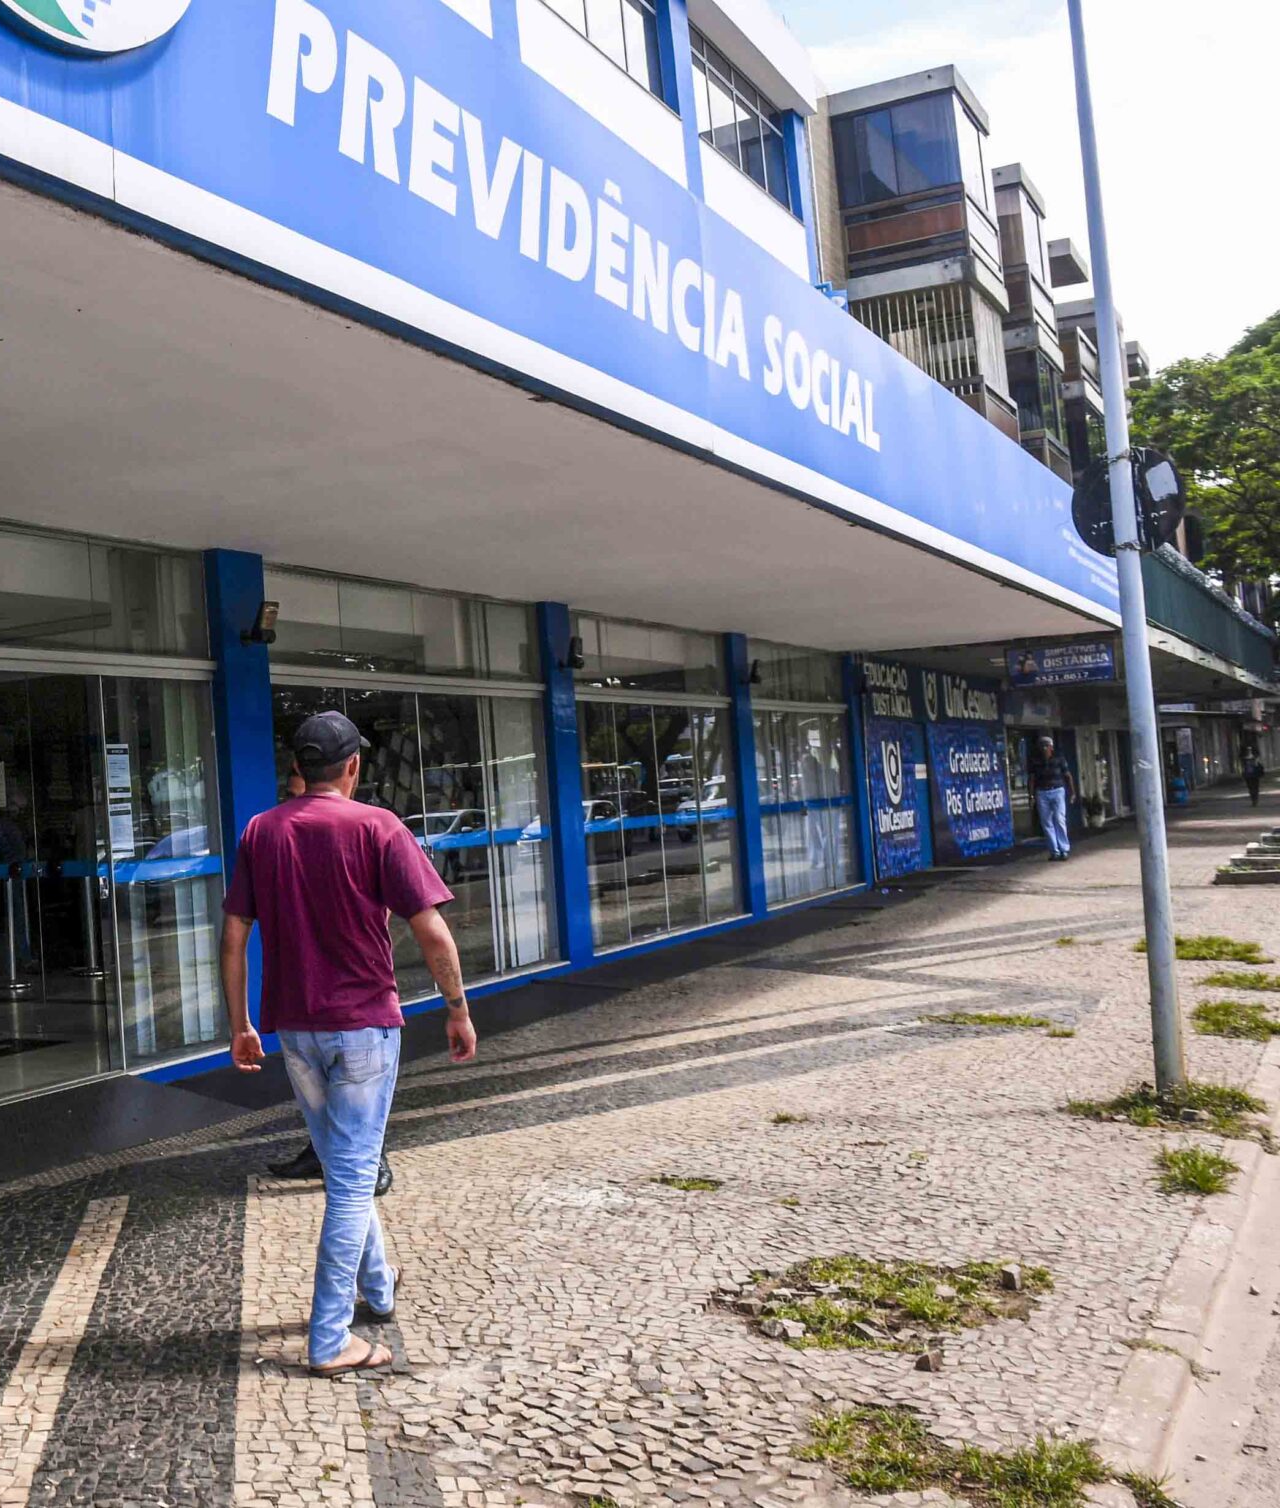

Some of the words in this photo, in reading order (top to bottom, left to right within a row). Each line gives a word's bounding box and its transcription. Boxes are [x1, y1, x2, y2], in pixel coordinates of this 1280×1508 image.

[266, 0, 750, 380] PREVIDÊNCIA
[763, 314, 881, 451] SOCIAL
[949, 745, 991, 777] Graduação
[945, 787, 963, 815] Pós
[965, 783, 1004, 814] Graduação
